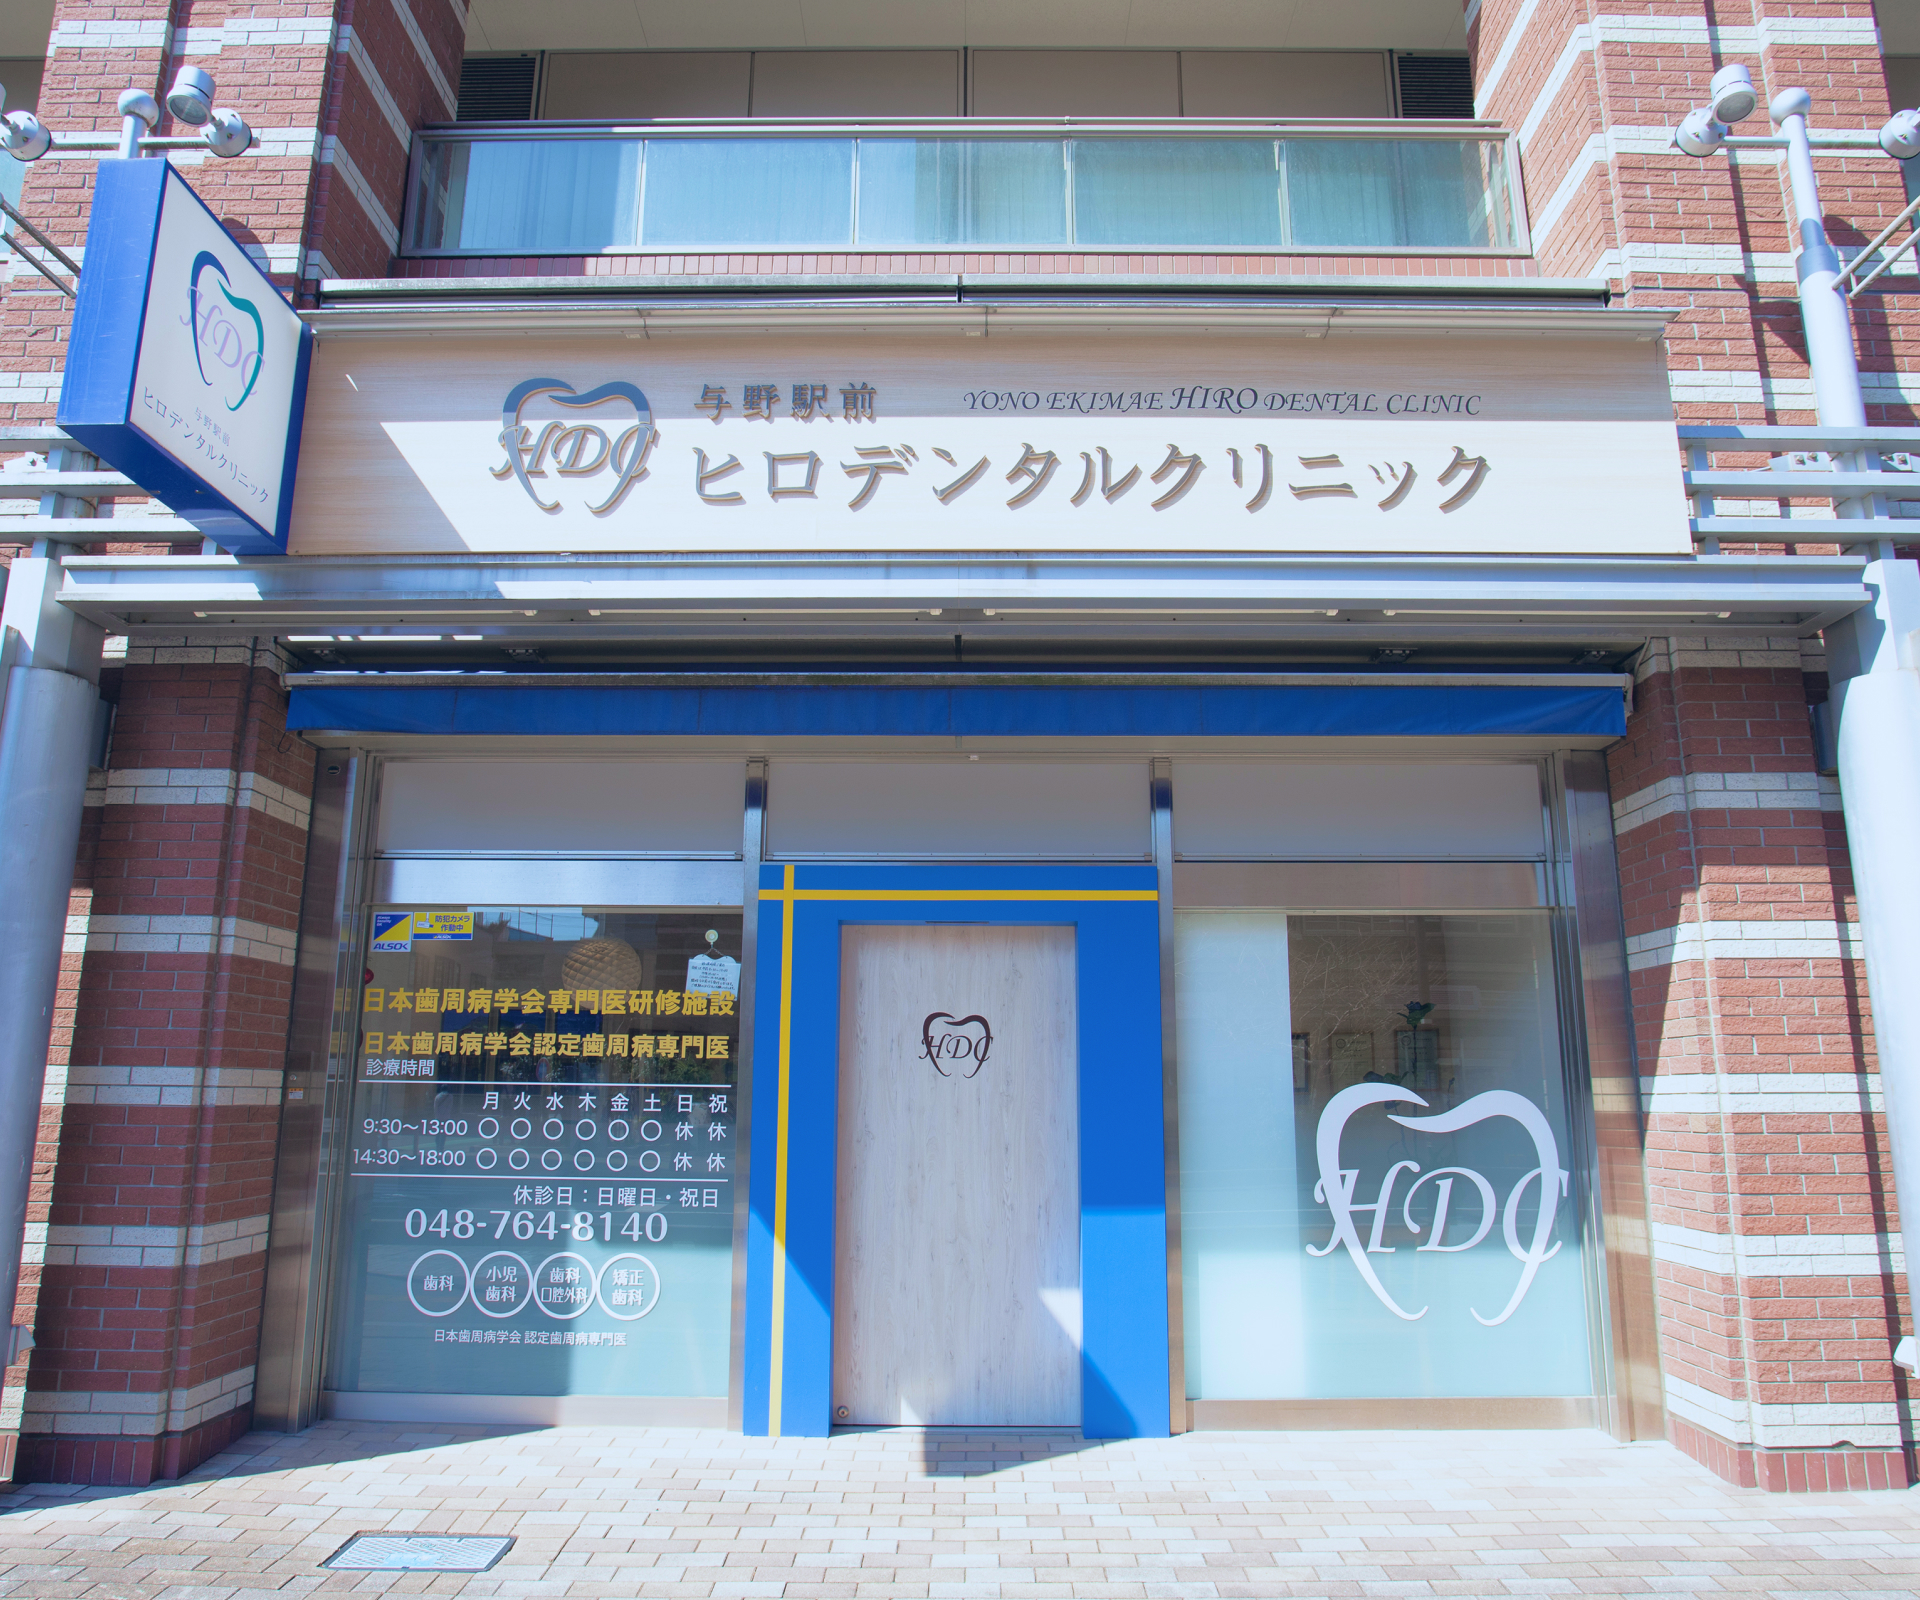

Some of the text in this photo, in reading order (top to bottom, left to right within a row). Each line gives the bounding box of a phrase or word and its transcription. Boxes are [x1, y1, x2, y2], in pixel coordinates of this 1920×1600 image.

[693, 381, 878, 421] 与野駅前
[963, 386, 1481, 416] YONO EKIMAE HIRO DENTAL CLINIC
[195, 407, 230, 446] 与野駅前
[144, 386, 268, 503] ヒロデンタルクリニック
[692, 442, 1490, 512] ヒロデンタルクリニック
[435, 915, 470, 923] 防犯カメラ
[363, 987, 735, 1016] 日本歯周病学会専門医研修施設
[364, 1031, 730, 1059] 日本歯周病学会認定歯周病専門医
[365, 1058, 435, 1077] 診療時間
[482, 1092, 728, 1113] 月 火 水 木 金 土 日 祝
[675, 1121, 694, 1141] 休
[708, 1122, 727, 1141] 休
[673, 1151, 693, 1172] 休
[706, 1152, 726, 1172] 休
[405, 1208, 668, 1242] 048-764-8140
[423, 1275, 454, 1291] 歯科
[486, 1266, 517, 1282] 小児
[550, 1267, 581, 1284] 歯科
[612, 1269, 644, 1286] 矯正
[485, 1286, 516, 1302] 歯科
[541, 1287, 588, 1304] 口腔外科
[611, 1289, 644, 1306] 歯科
[434, 1329, 627, 1346] 日本歯周病学会 認定歯周病専門医
